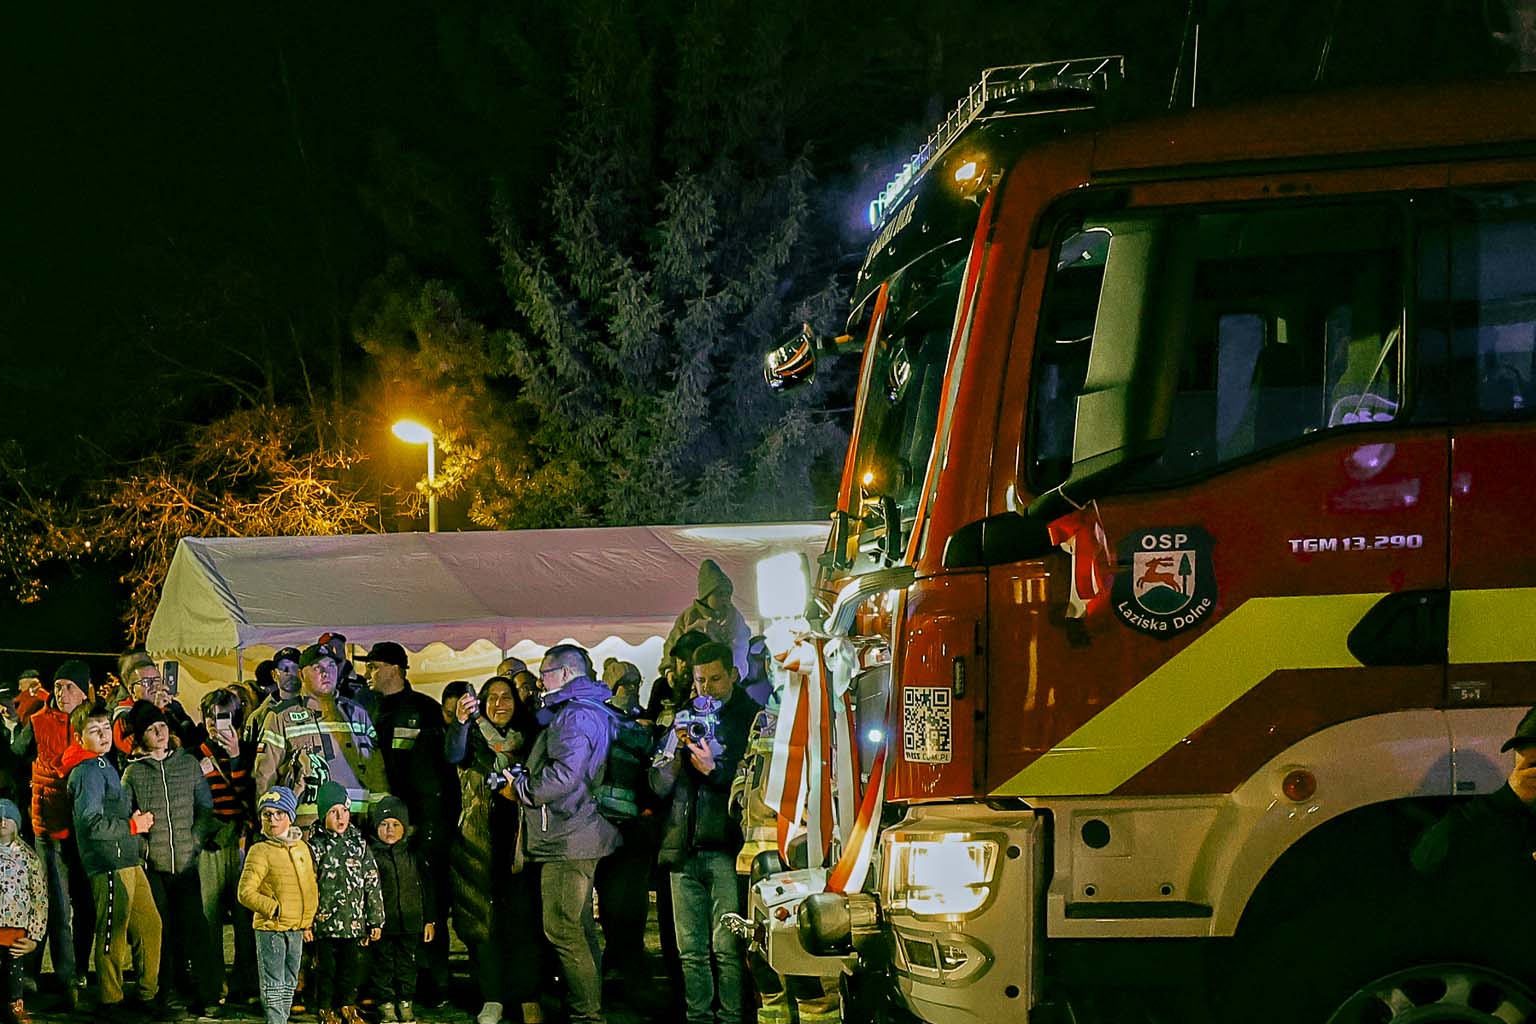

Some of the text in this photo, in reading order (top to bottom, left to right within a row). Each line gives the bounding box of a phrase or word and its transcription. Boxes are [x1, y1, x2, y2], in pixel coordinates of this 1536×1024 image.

[1141, 534, 1188, 549] OSP
[1288, 534, 1424, 553] TGM 13.290
[1173, 597, 1212, 629] Dolne
